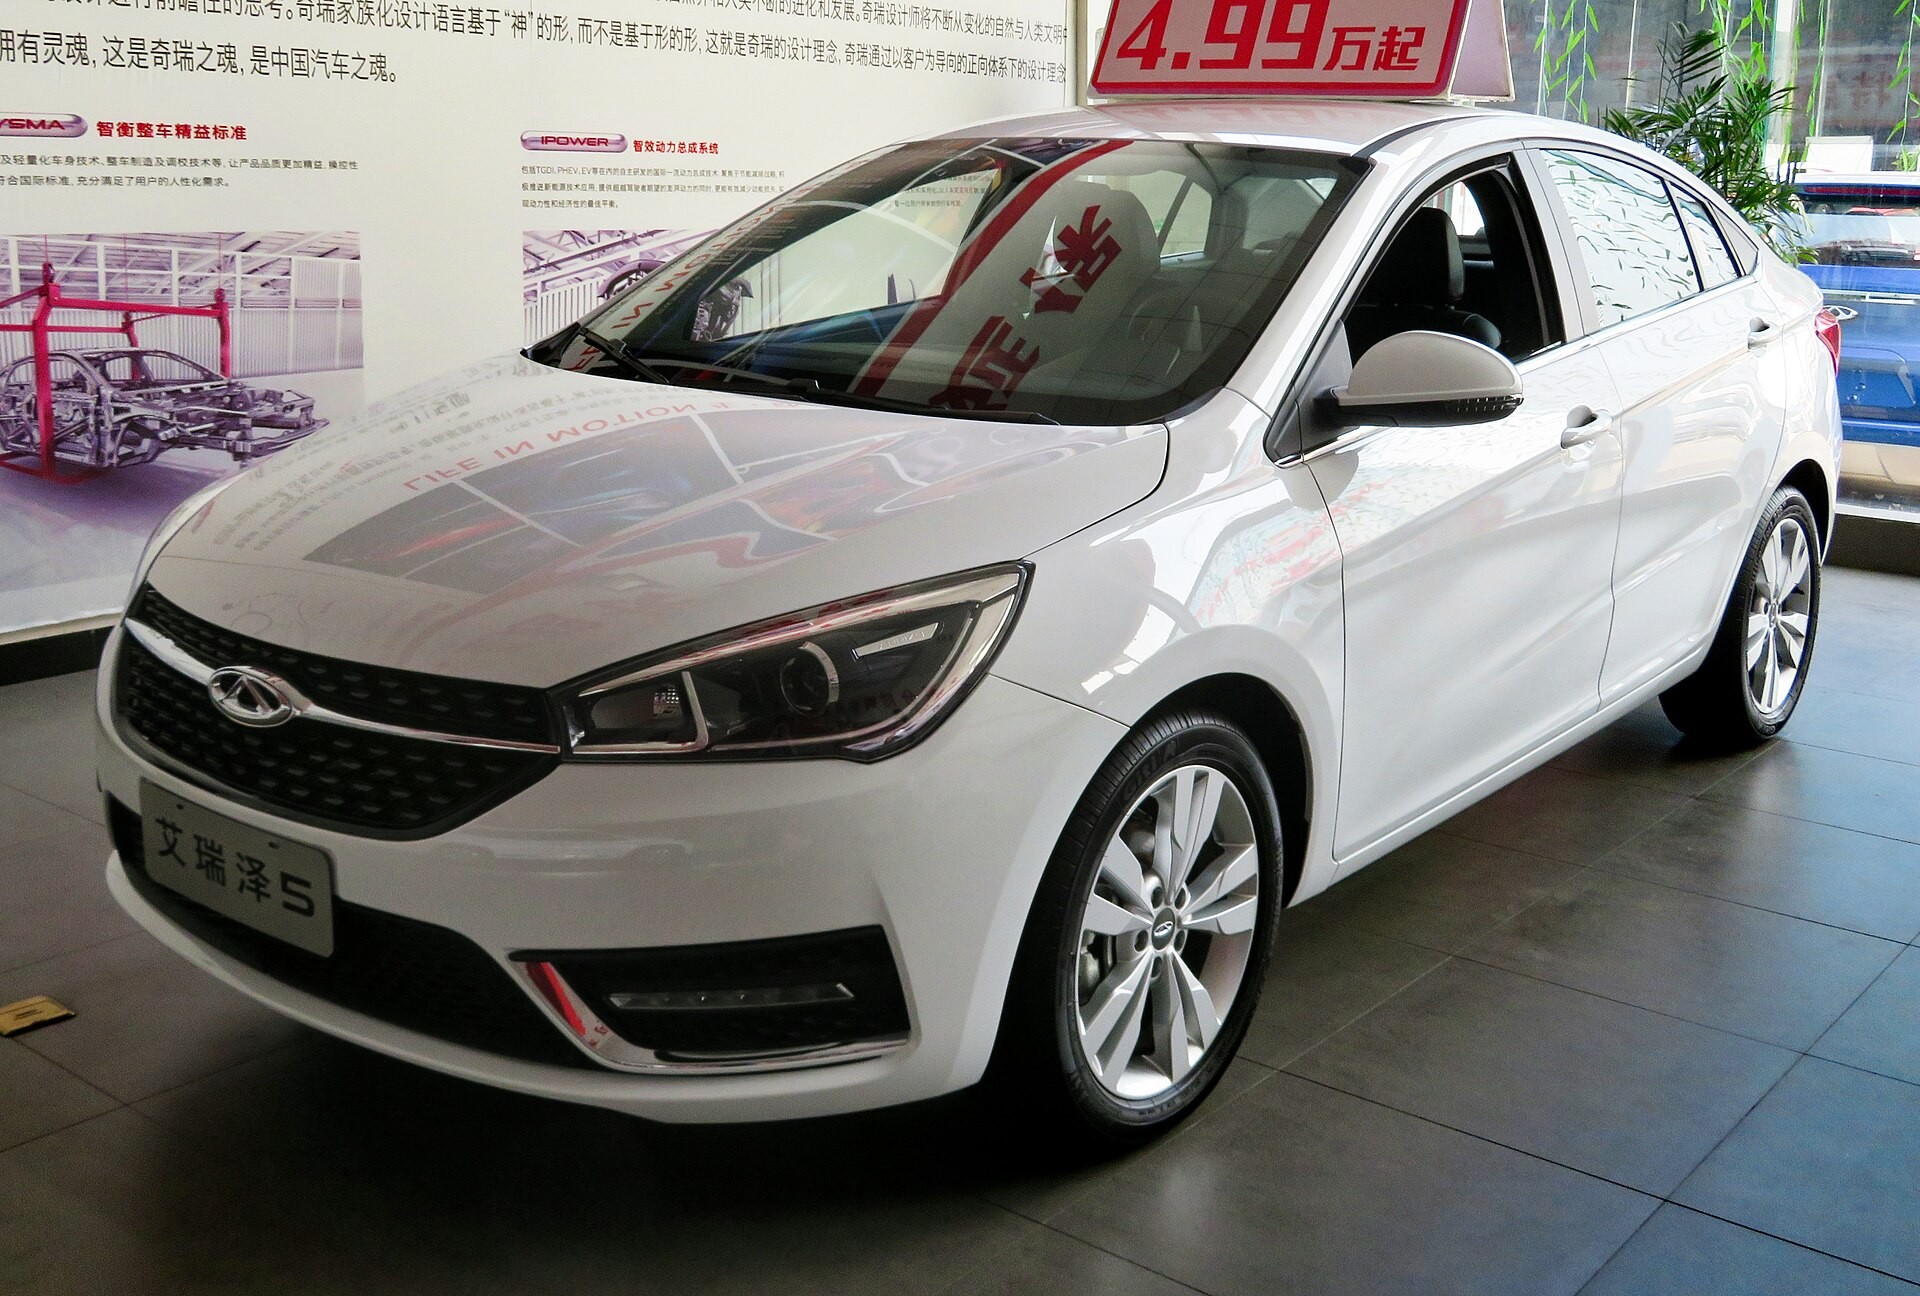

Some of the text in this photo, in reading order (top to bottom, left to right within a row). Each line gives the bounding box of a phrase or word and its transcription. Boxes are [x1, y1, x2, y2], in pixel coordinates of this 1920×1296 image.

[97, 121, 247, 141] 智衡整车精益标准
[541, 136, 608, 146] IPOWER
[633, 140, 719, 155] 智效动力总成系统
[156, 817, 315, 917] 艾瑞泽5
